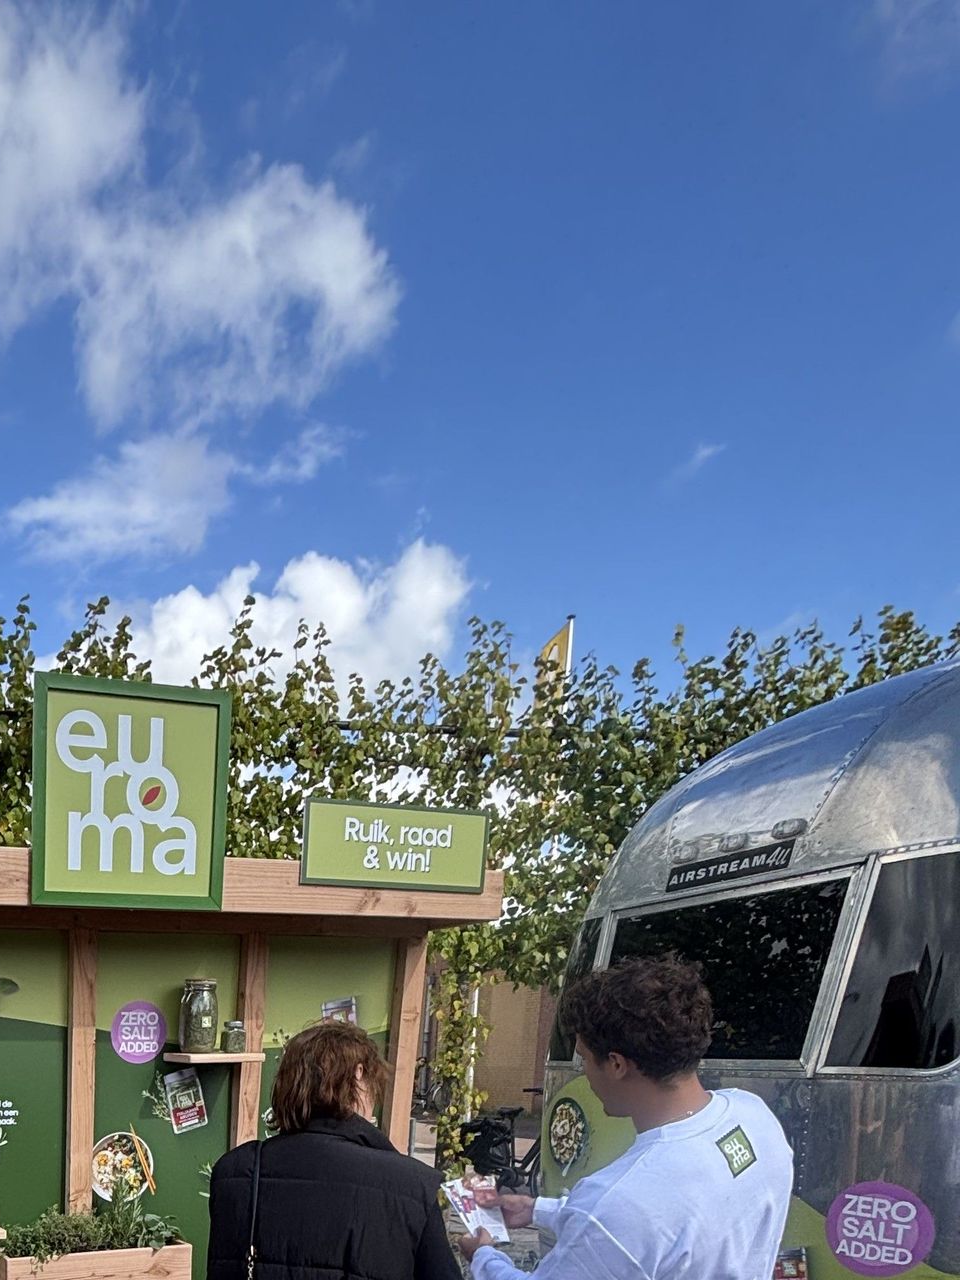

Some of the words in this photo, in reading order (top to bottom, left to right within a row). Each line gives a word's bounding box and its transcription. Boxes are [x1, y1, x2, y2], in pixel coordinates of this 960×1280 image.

[344, 816, 395, 846] Ruik,
[400, 824, 453, 848] raad
[363, 845, 380, 870] &
[386, 847, 431, 873] win!
[120, 1012, 159, 1026] ZERO
[121, 1026, 157, 1040] SALT
[119, 1041, 159, 1053] ADDED
[2, 1100, 13, 1108] de
[3, 1109, 19, 1117] een
[842, 1194, 917, 1222] ZERO
[842, 1217, 912, 1245] SALT
[835, 1239, 913, 1265] ADDED
